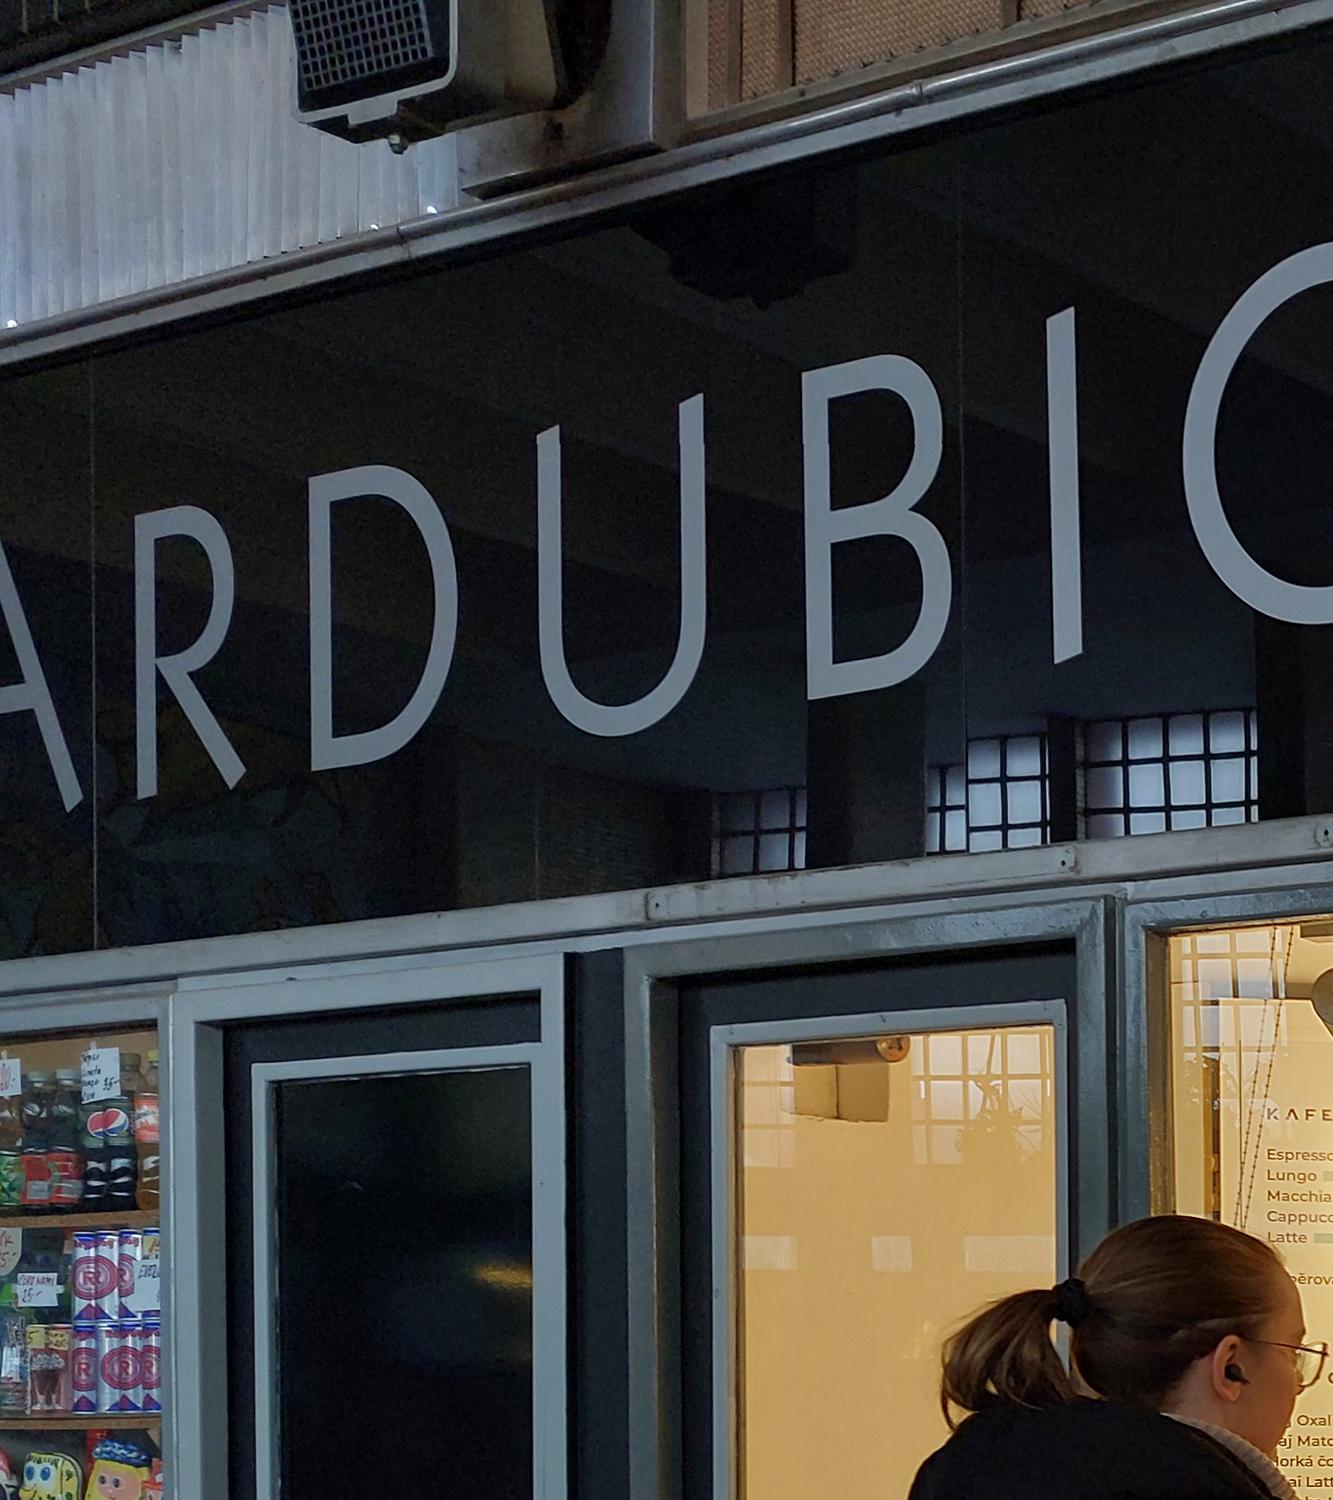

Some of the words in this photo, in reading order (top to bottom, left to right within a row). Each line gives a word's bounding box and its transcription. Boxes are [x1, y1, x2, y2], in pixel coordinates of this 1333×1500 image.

[1267, 1108, 1333, 1121] KAFE
[1267, 1169, 1317, 1184] Lungo
[1267, 1231, 1308, 1243] Latte
[1278, 1435, 1292, 1449] aj
[1288, 1476, 1303, 1488] ai
